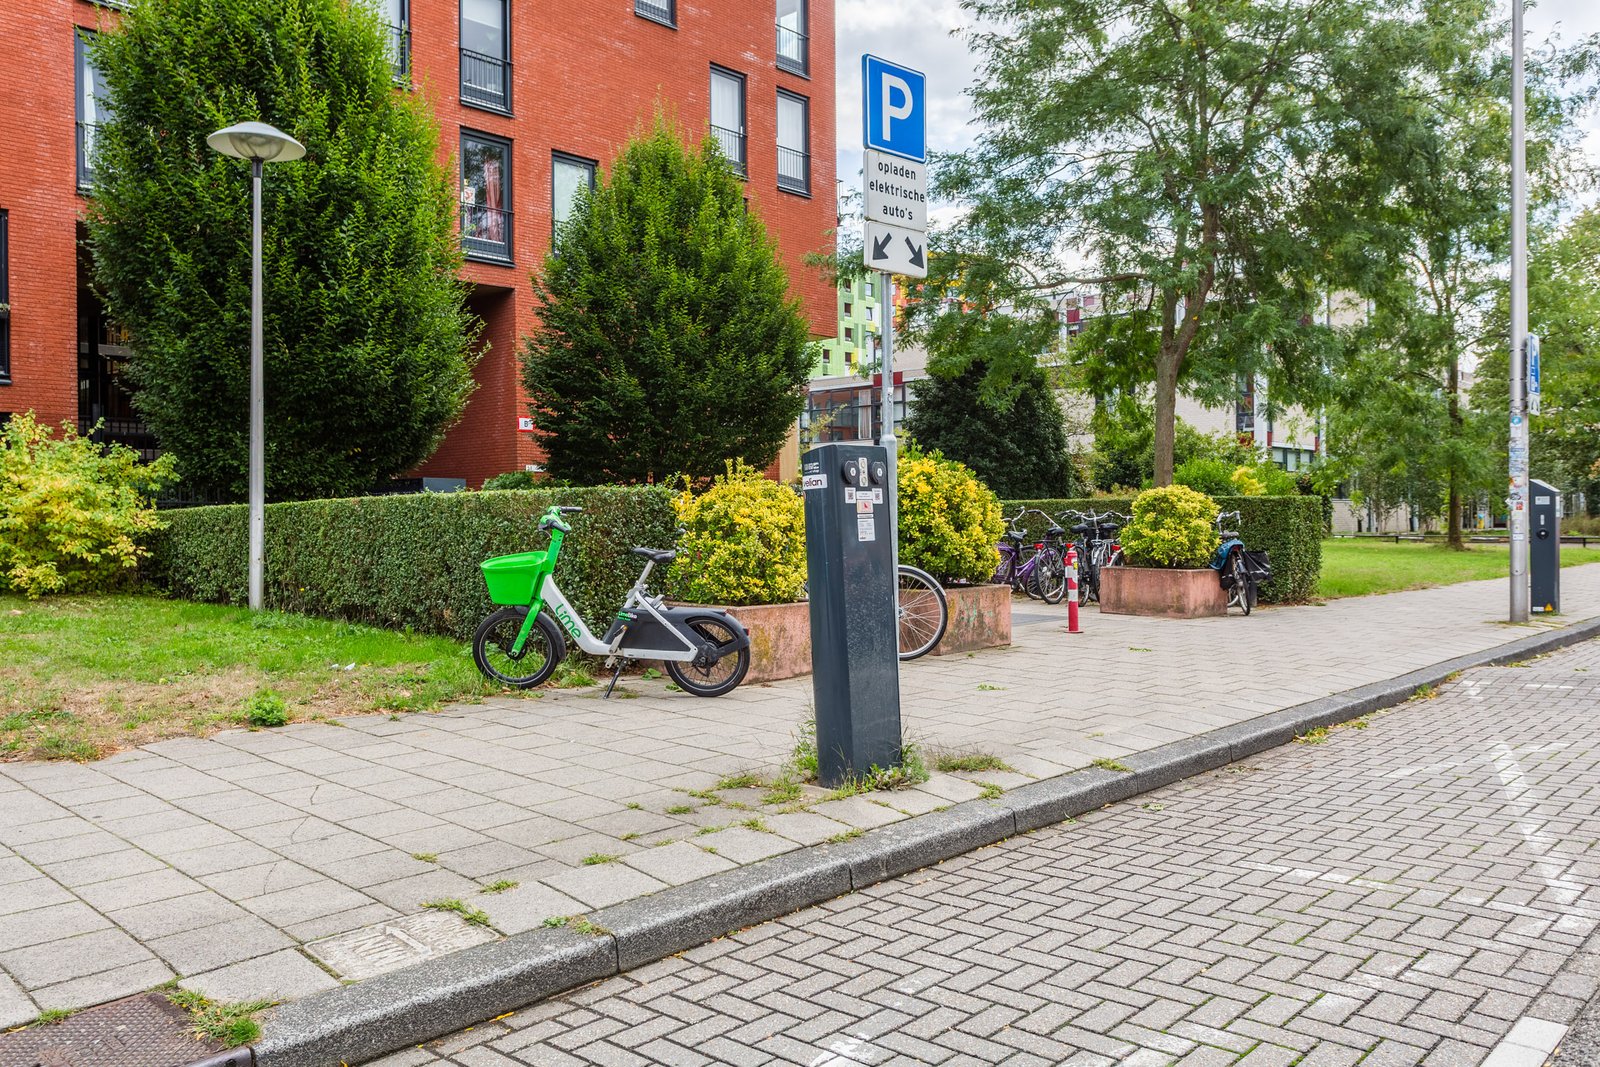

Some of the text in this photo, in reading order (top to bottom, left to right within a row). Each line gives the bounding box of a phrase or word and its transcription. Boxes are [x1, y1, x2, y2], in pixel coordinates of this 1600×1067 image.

[882, 72, 913, 141] P
[878, 158, 916, 181] opladen
[869, 181, 925, 202] elektrische
[882, 204, 913, 220] auto's
[555, 603, 581, 638] Lime
